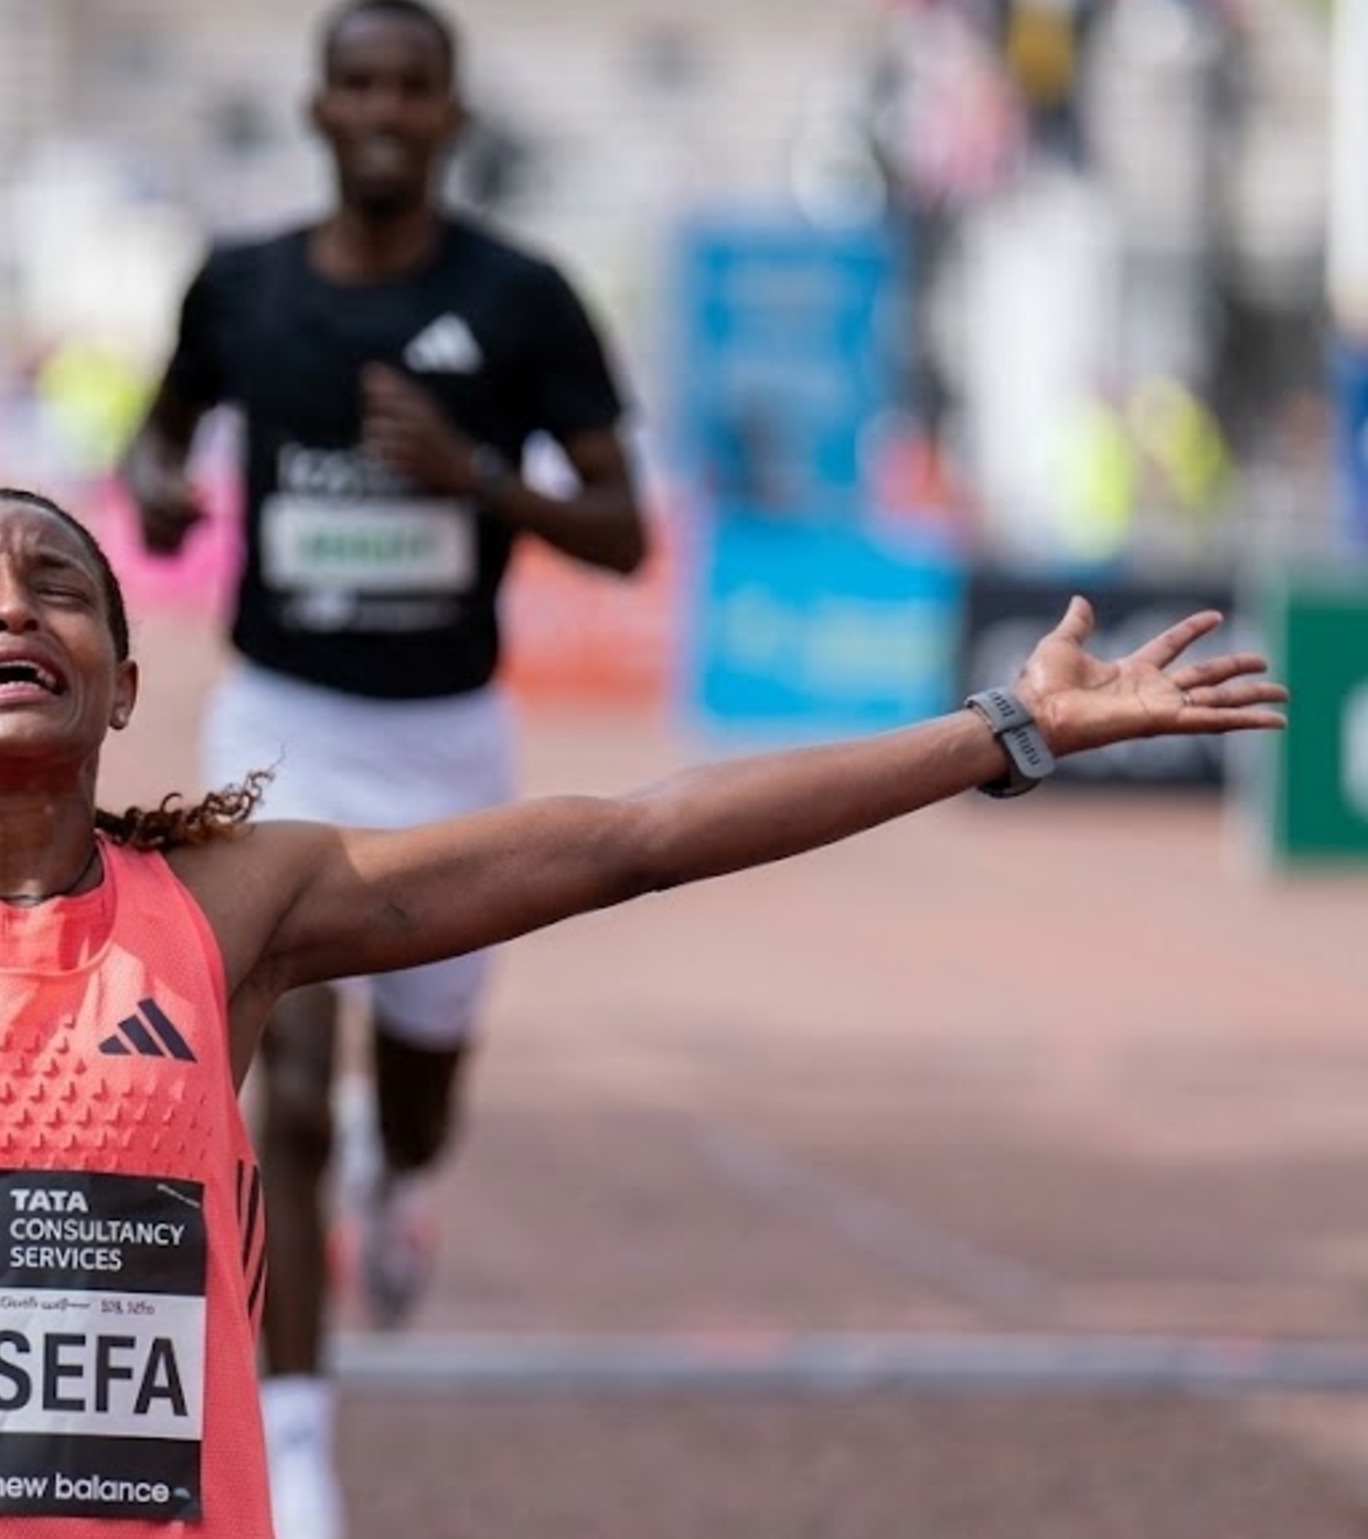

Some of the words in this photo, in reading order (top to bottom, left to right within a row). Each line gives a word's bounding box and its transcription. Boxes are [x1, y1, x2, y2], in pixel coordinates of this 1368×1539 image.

[10, 1189, 89, 1212] TATA
[9, 1218, 185, 1246] CONSULTANCY
[9, 1247, 122, 1271] SERVICES
[55, 1472, 170, 1503] balance
